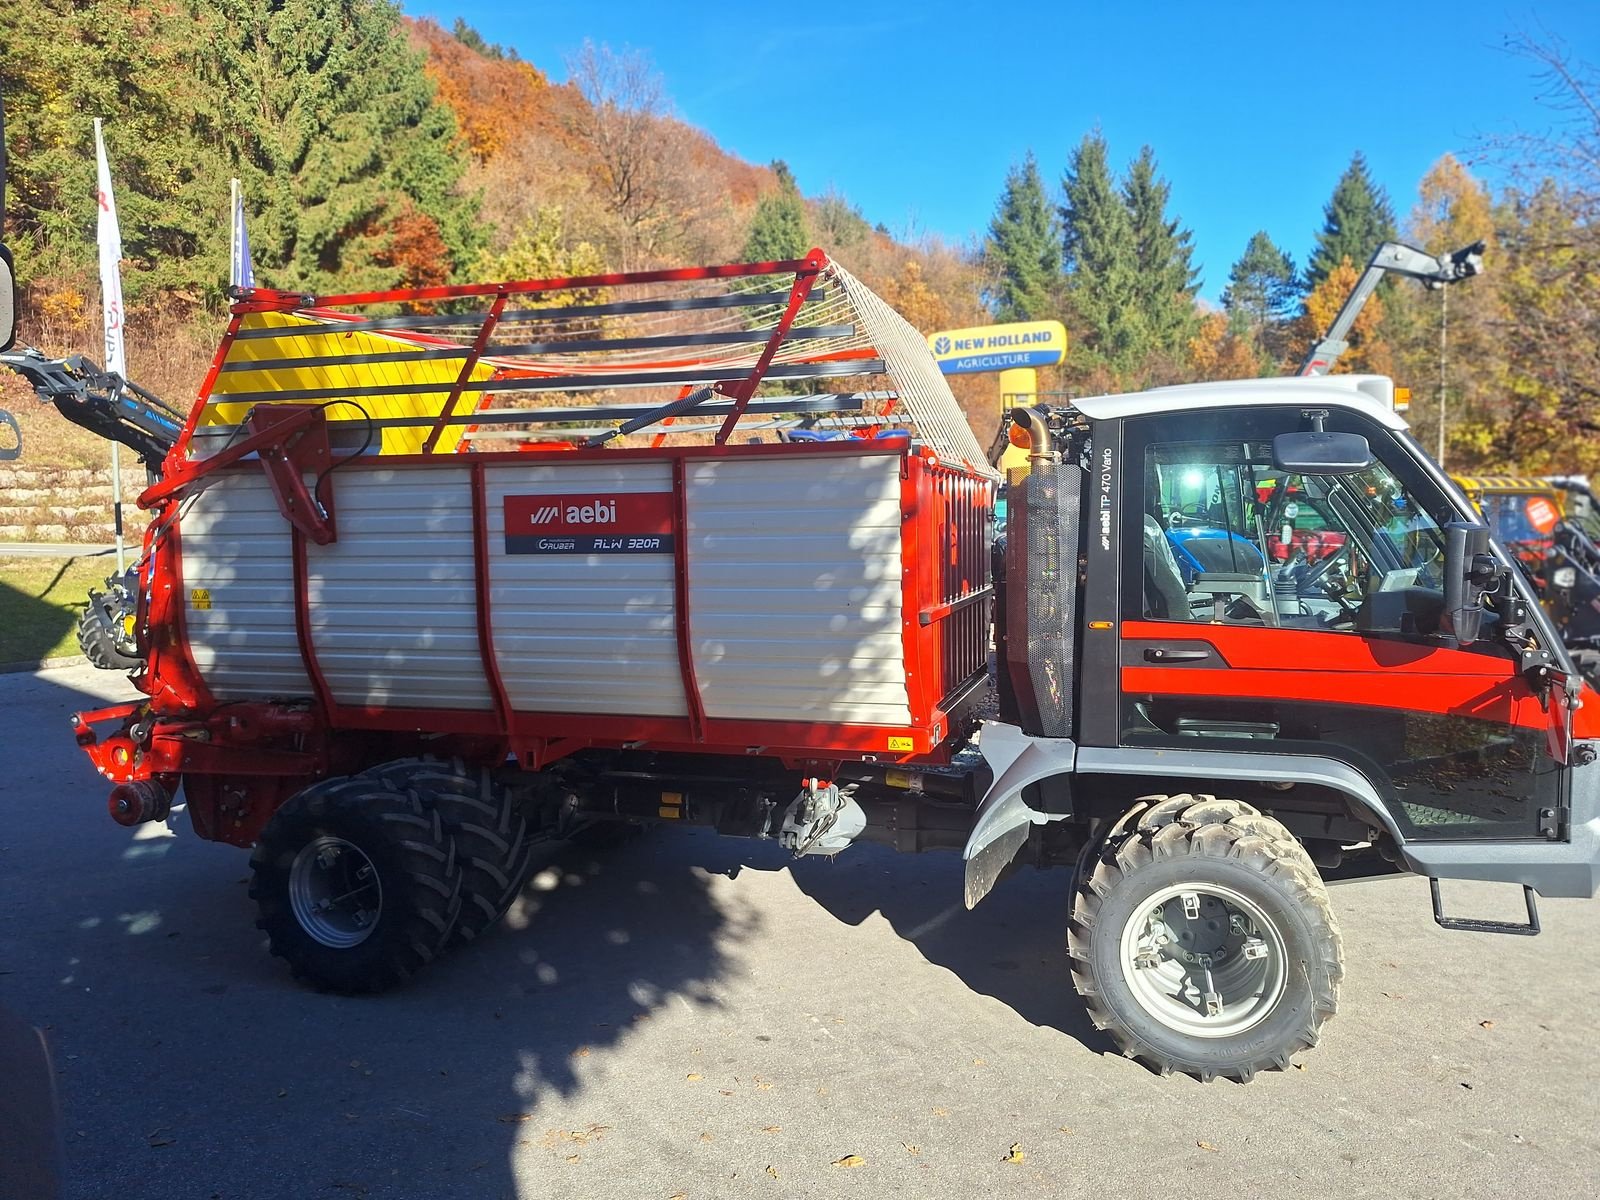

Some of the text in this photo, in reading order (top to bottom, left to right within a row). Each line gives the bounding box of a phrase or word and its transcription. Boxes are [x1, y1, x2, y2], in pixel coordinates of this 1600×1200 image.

[955, 331, 1052, 351] NEW HOLLAND
[957, 353, 1031, 369] AGRICULTURE
[1100, 447, 1112, 534] aebi TP 470 Vario
[566, 500, 616, 524] aebi
